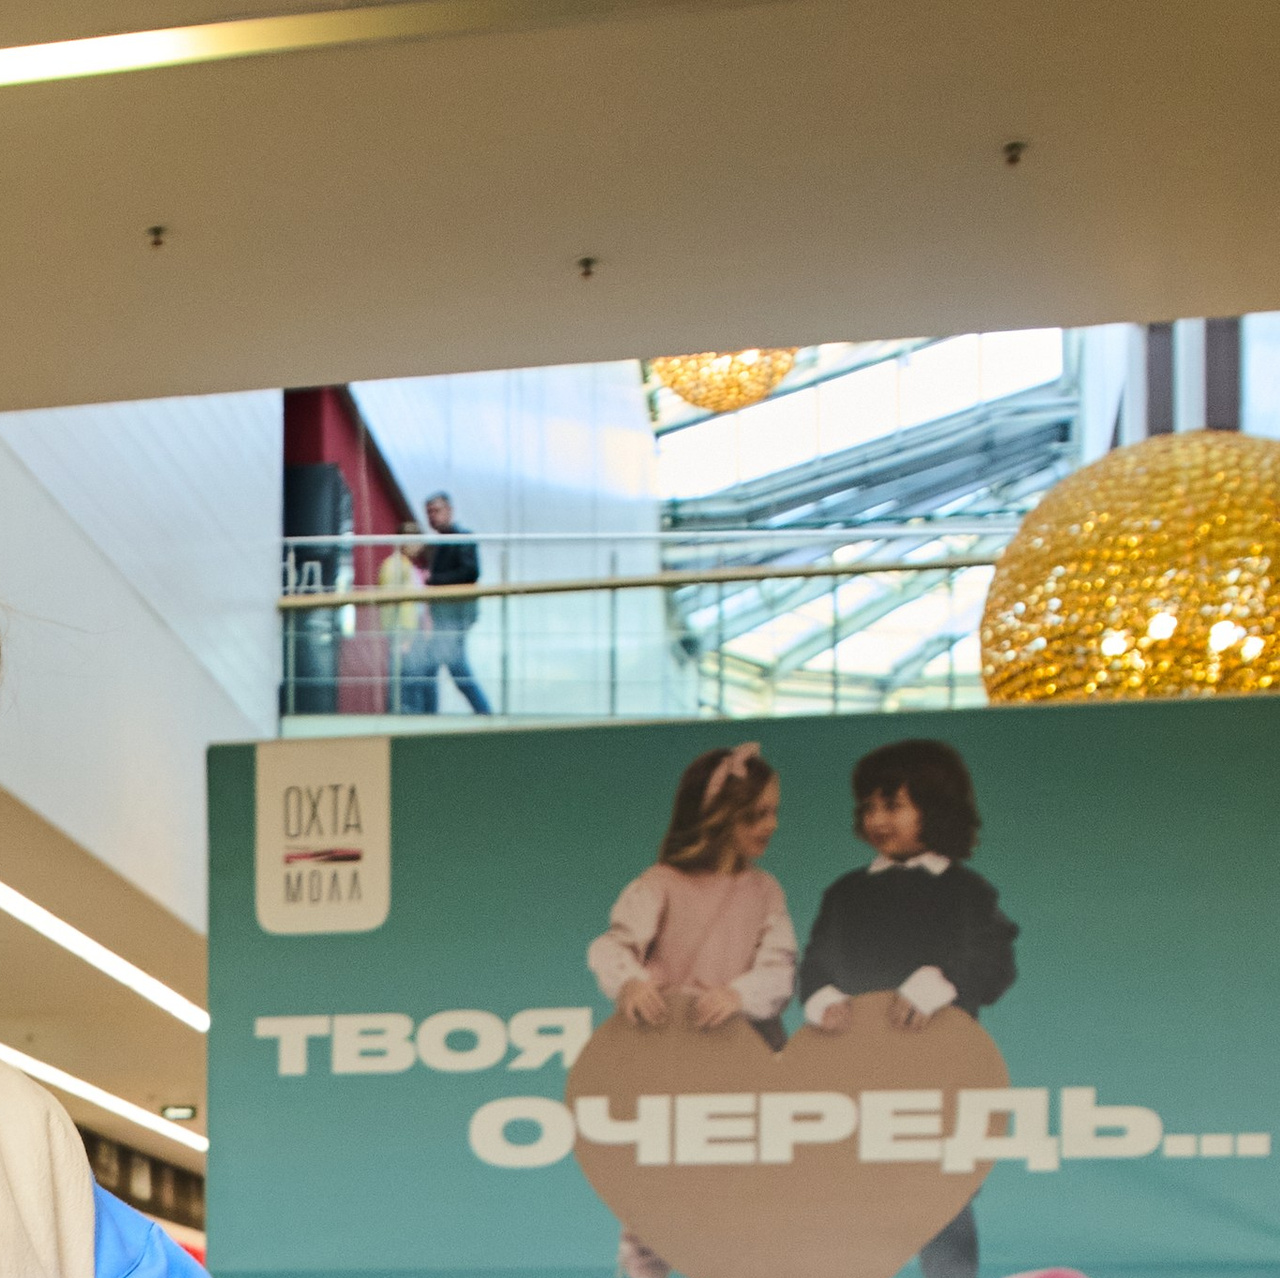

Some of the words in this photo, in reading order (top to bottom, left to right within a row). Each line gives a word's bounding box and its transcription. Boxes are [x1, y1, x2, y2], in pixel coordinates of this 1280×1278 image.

[283, 783, 364, 838] ОХТА
[255, 1007, 592, 1076] ТВОЯ
[467, 1086, 1272, 1174] ОЧЕРЕДЬ...
